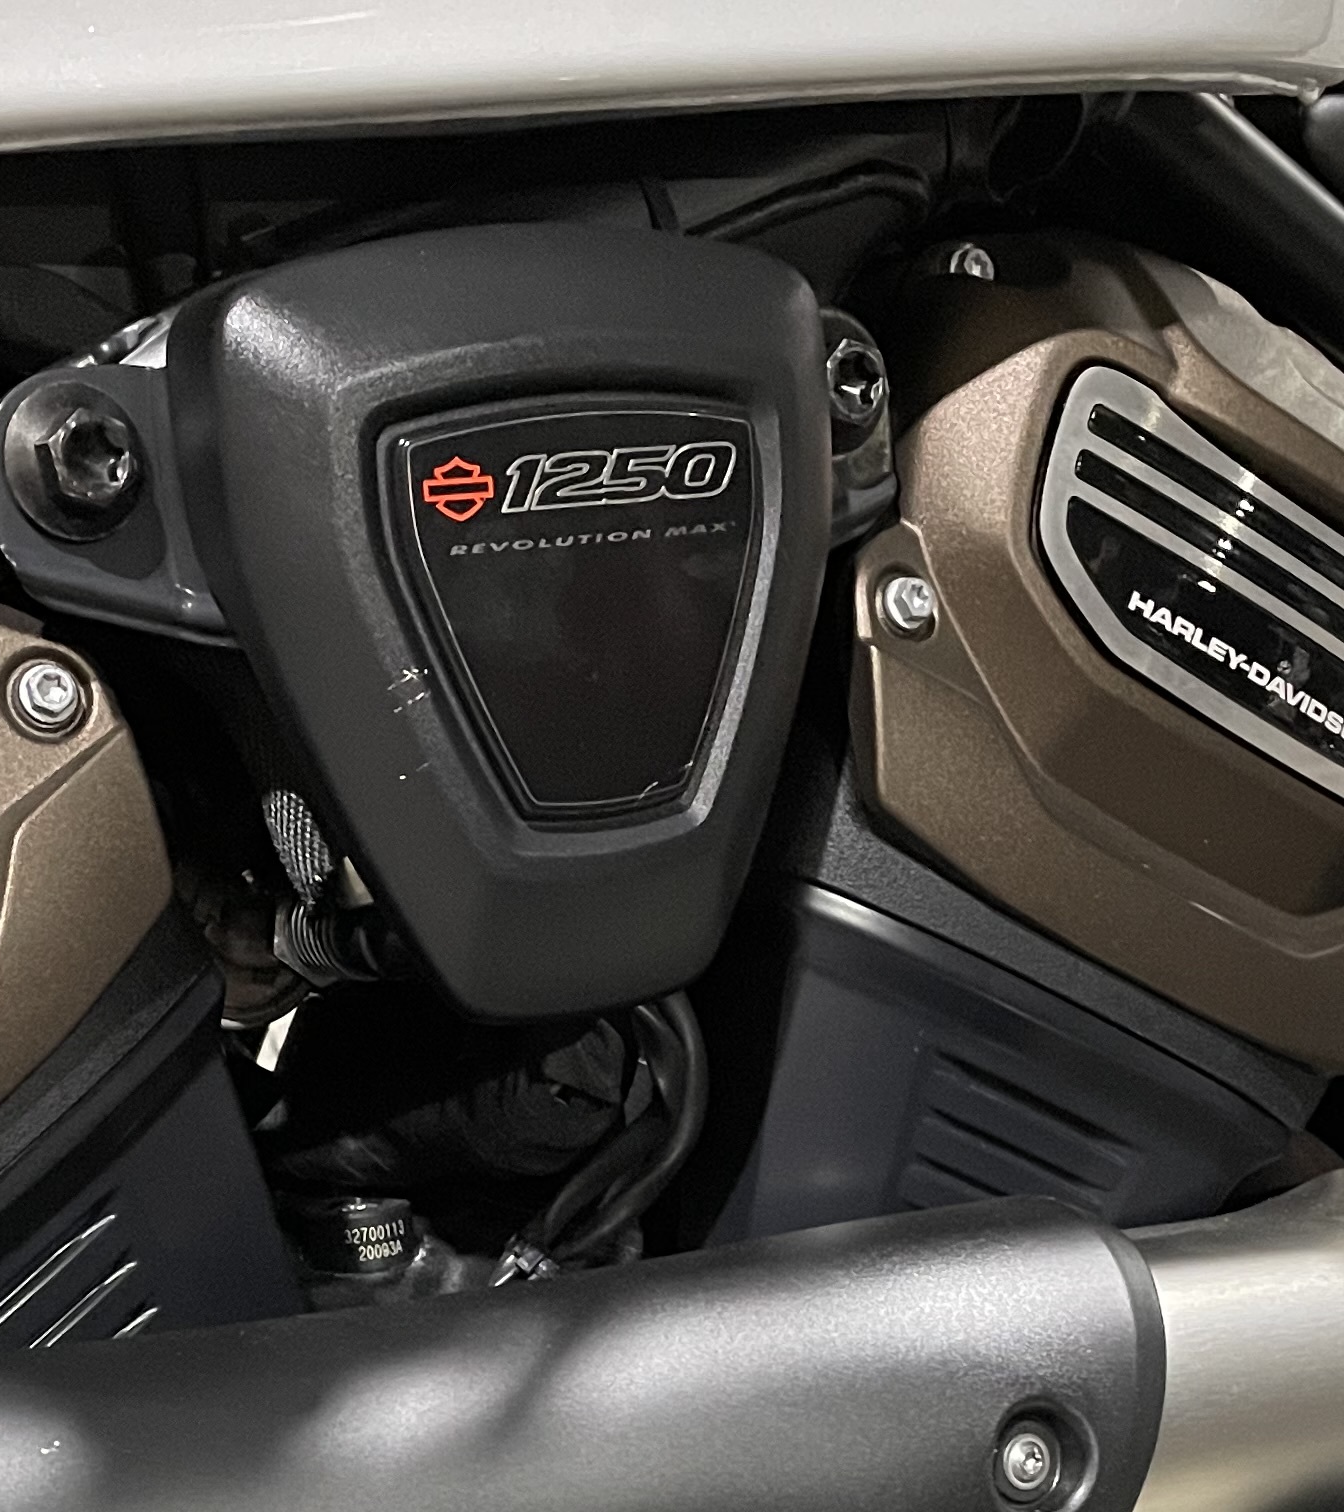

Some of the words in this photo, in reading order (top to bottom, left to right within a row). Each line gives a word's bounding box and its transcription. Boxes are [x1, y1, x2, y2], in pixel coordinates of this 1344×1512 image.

[501, 441, 736, 514] 1250
[450, 529, 652, 556] REVOLUTION
[664, 522, 731, 538] MAX
